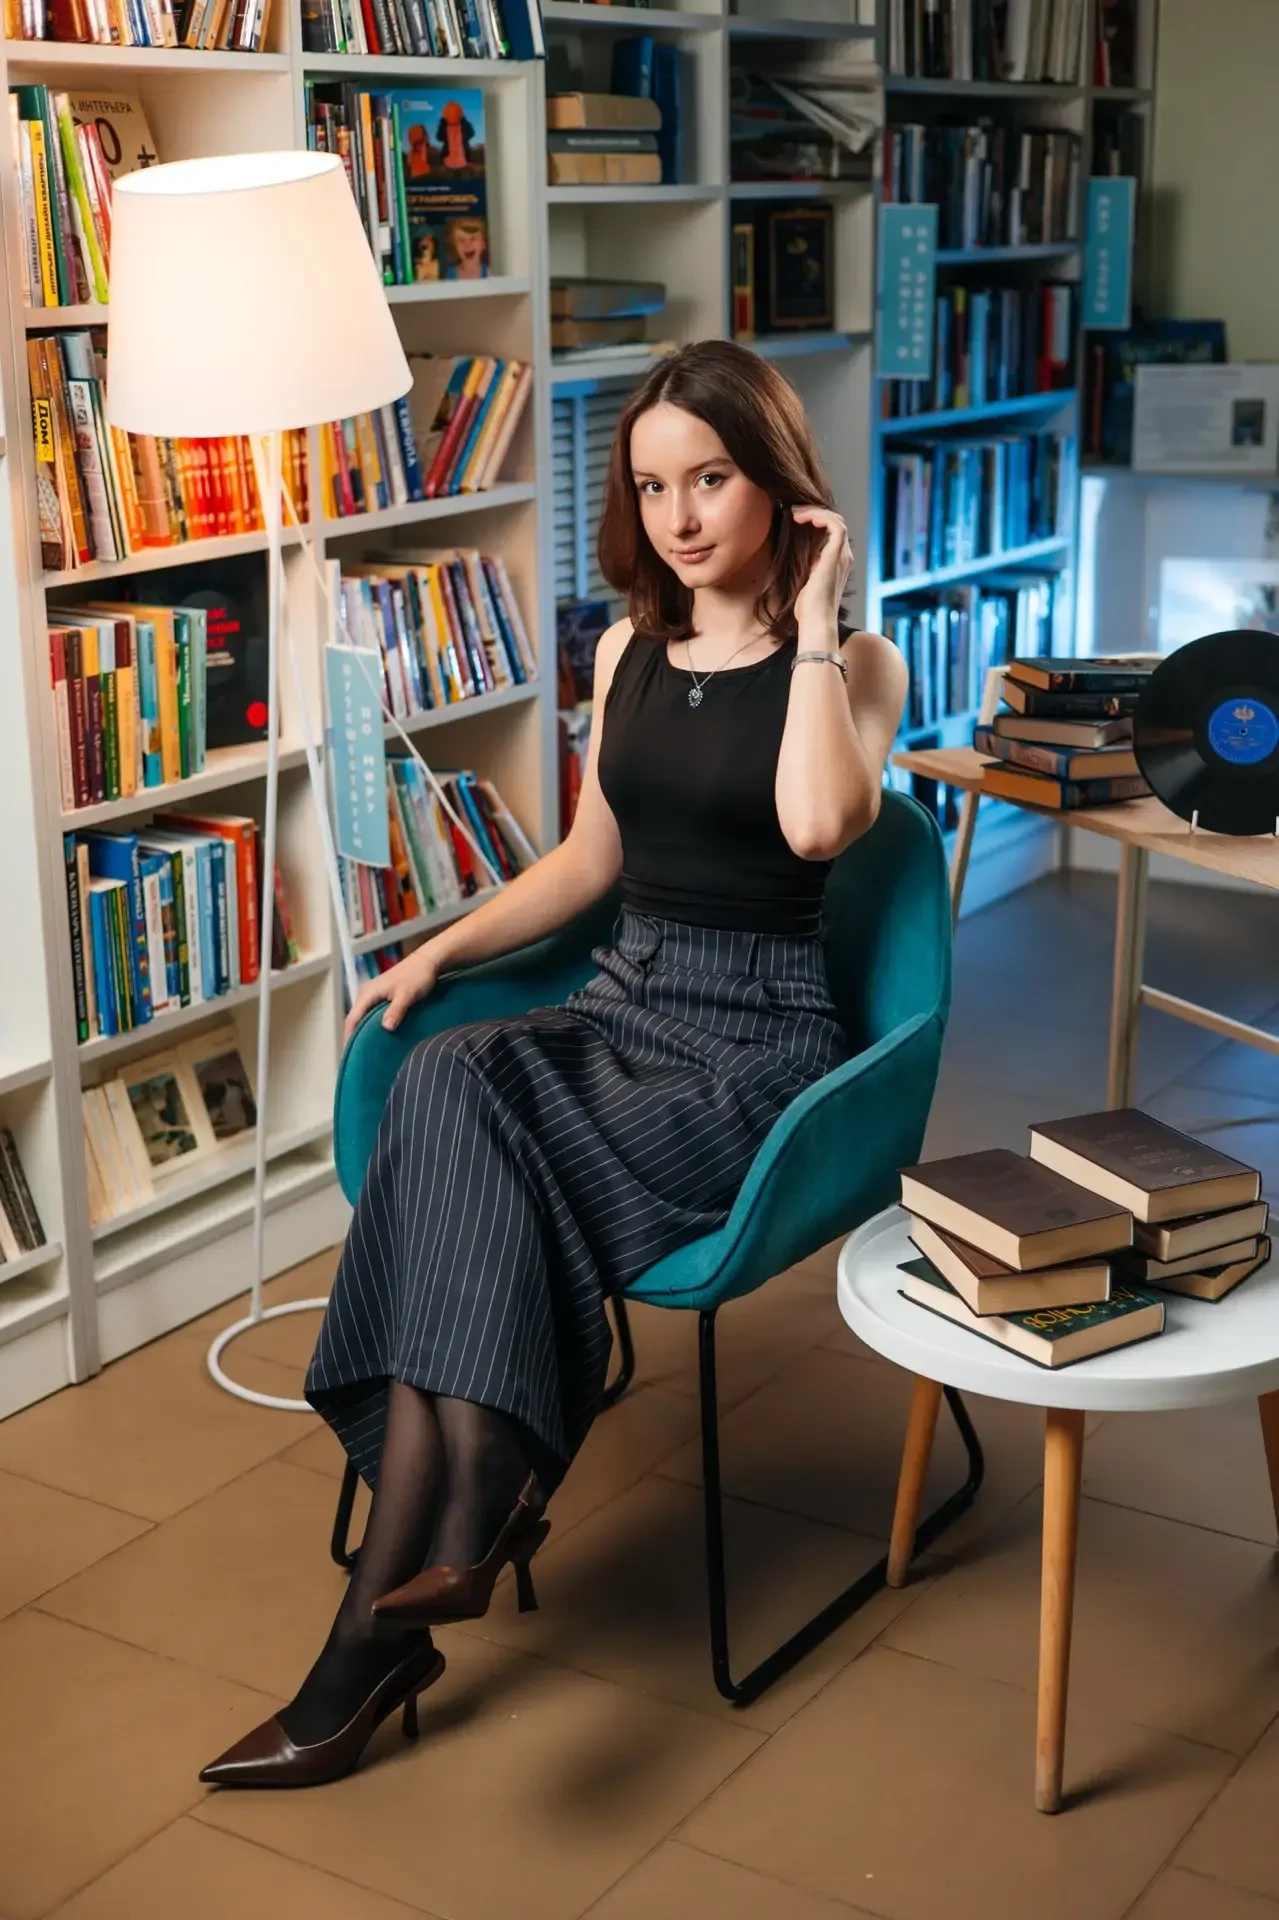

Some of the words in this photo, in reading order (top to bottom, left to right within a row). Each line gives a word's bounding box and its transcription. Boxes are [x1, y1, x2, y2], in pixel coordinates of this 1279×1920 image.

[77, 100, 133, 114] ИНТЕРЬЕРА
[38, 153, 47, 200] КВАРТИРЫ
[44, 203, 52, 240] ДИЗАЙН
[48, 252, 56, 294] ИНТЕРЬЕР
